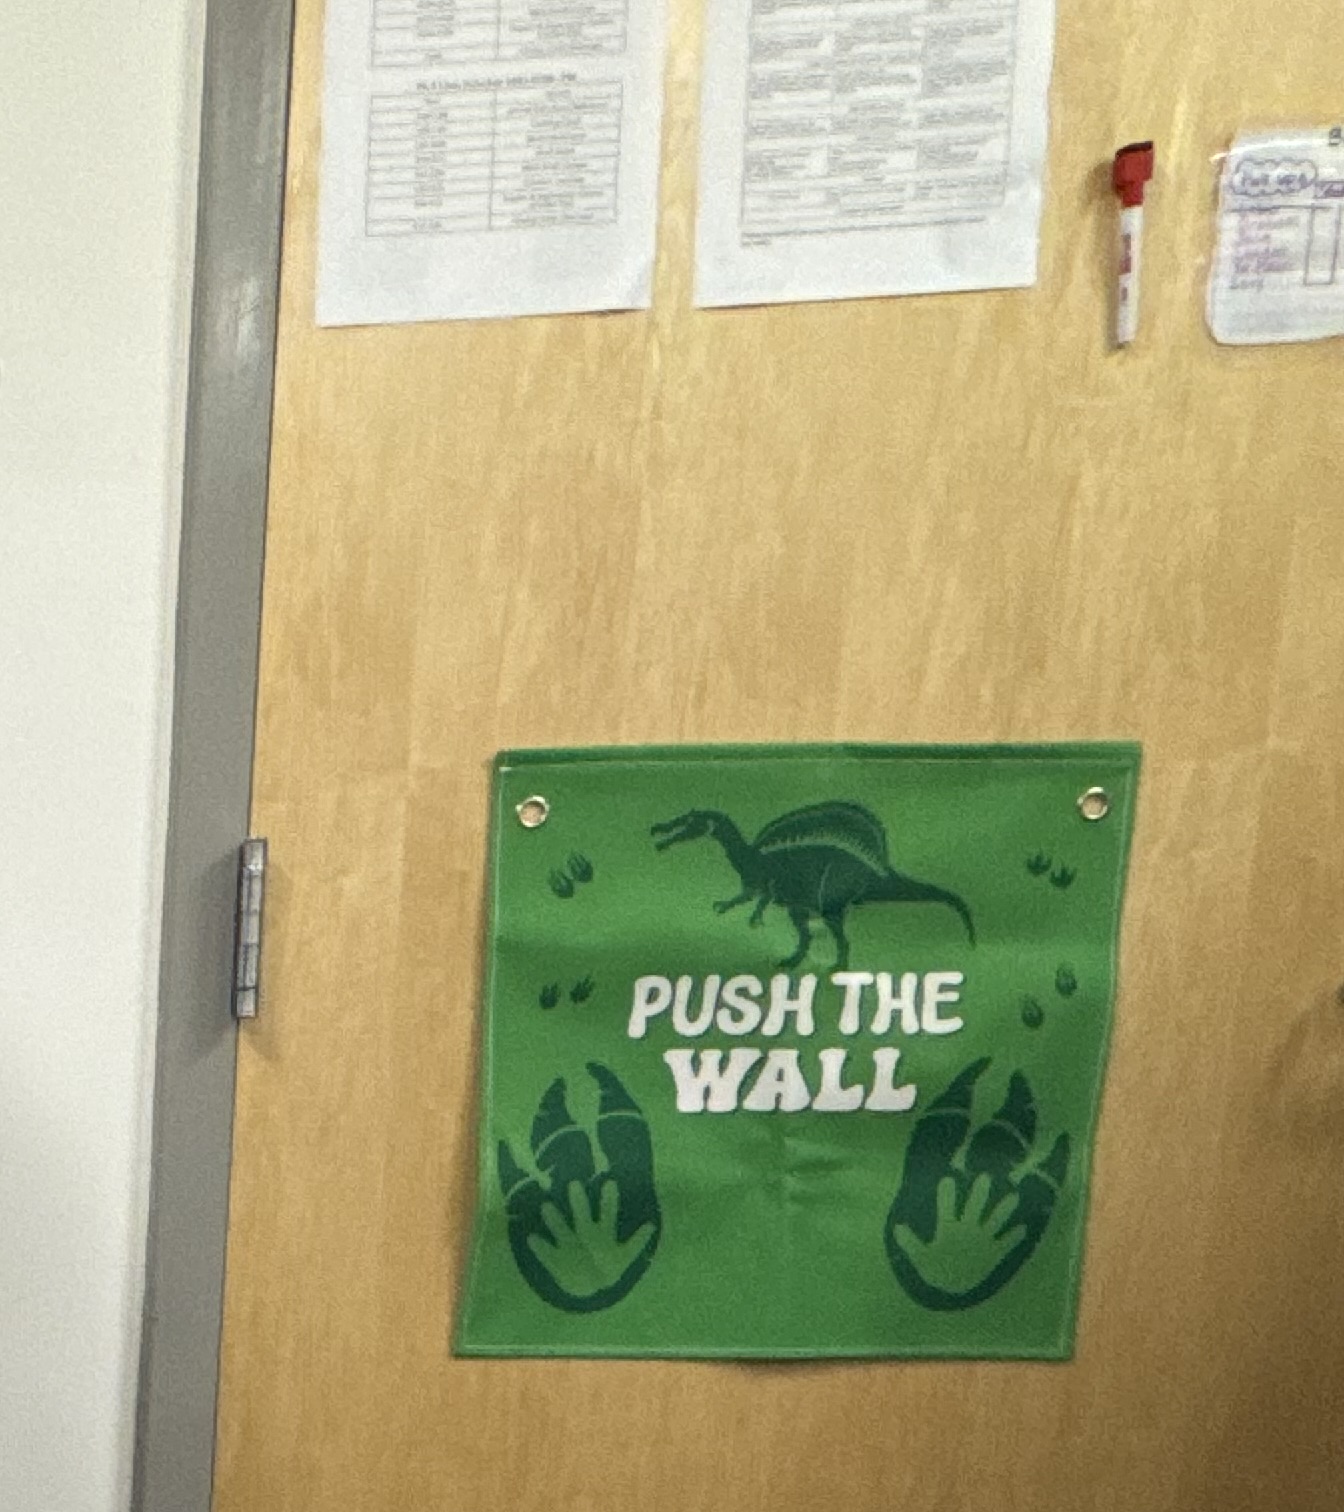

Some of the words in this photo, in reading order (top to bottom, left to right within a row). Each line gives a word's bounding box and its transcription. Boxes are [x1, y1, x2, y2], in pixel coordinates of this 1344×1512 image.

[627, 972, 818, 1038] PUSH
[831, 971, 963, 1035] THE
[663, 1048, 917, 1112] WALL
